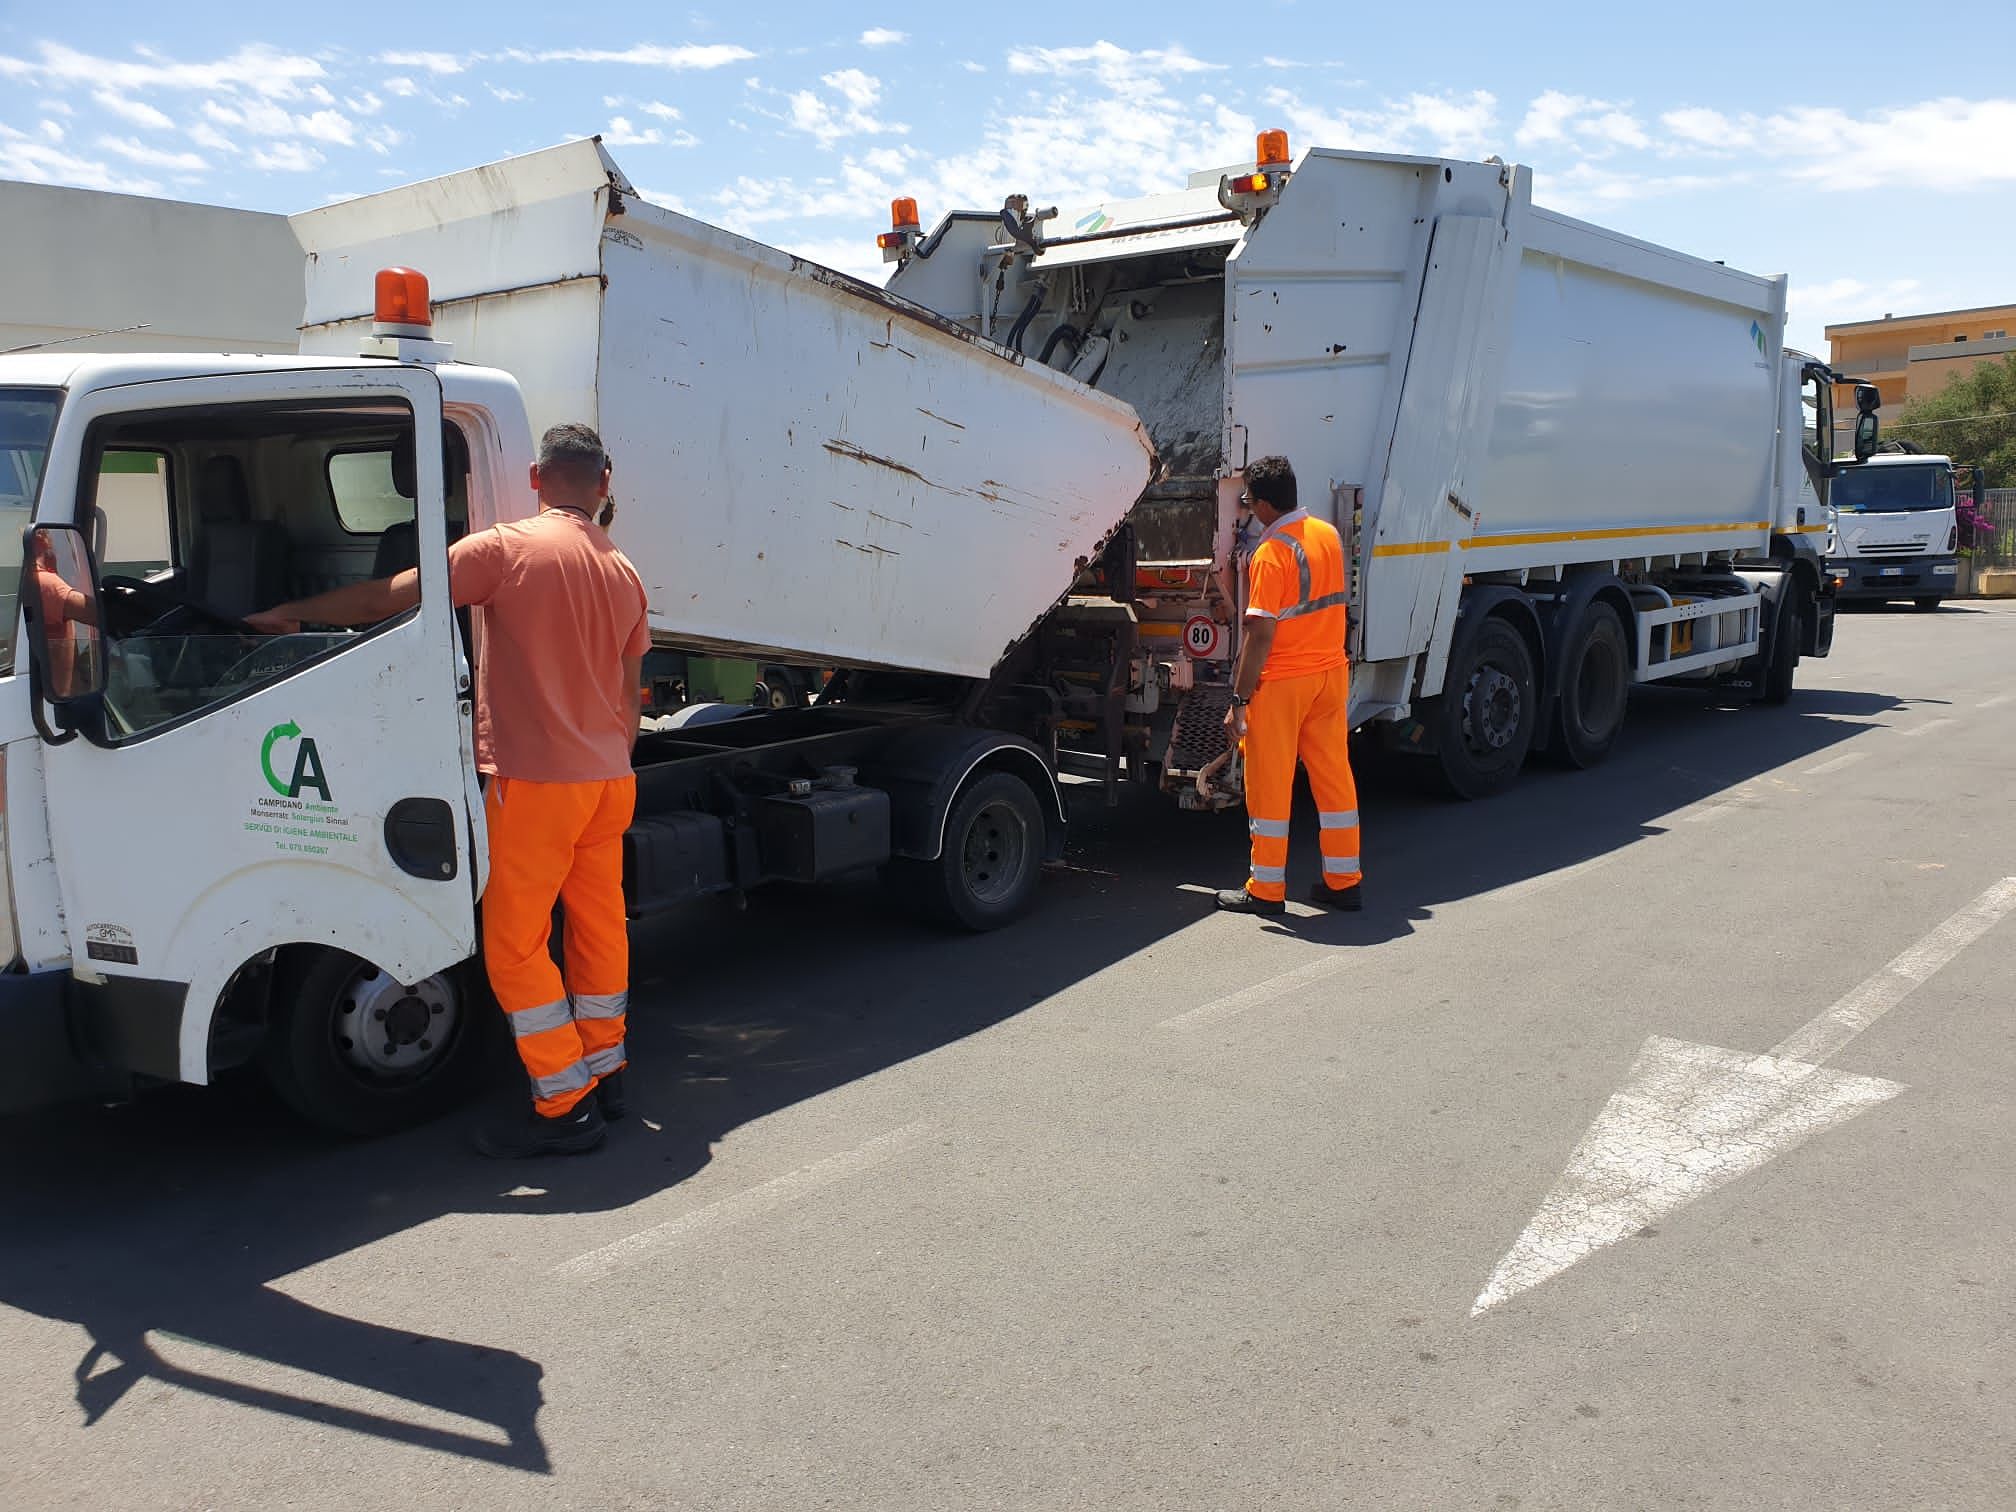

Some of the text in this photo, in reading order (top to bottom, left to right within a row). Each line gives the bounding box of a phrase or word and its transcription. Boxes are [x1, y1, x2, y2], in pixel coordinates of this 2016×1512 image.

[1193, 627, 1209, 644] 80
[258, 798, 339, 813] CAMPIDANO Ambiente
[326, 816, 349, 826] Sinnai
[244, 822, 359, 843] SERVIZI DI IGIENE AMBIENTALE
